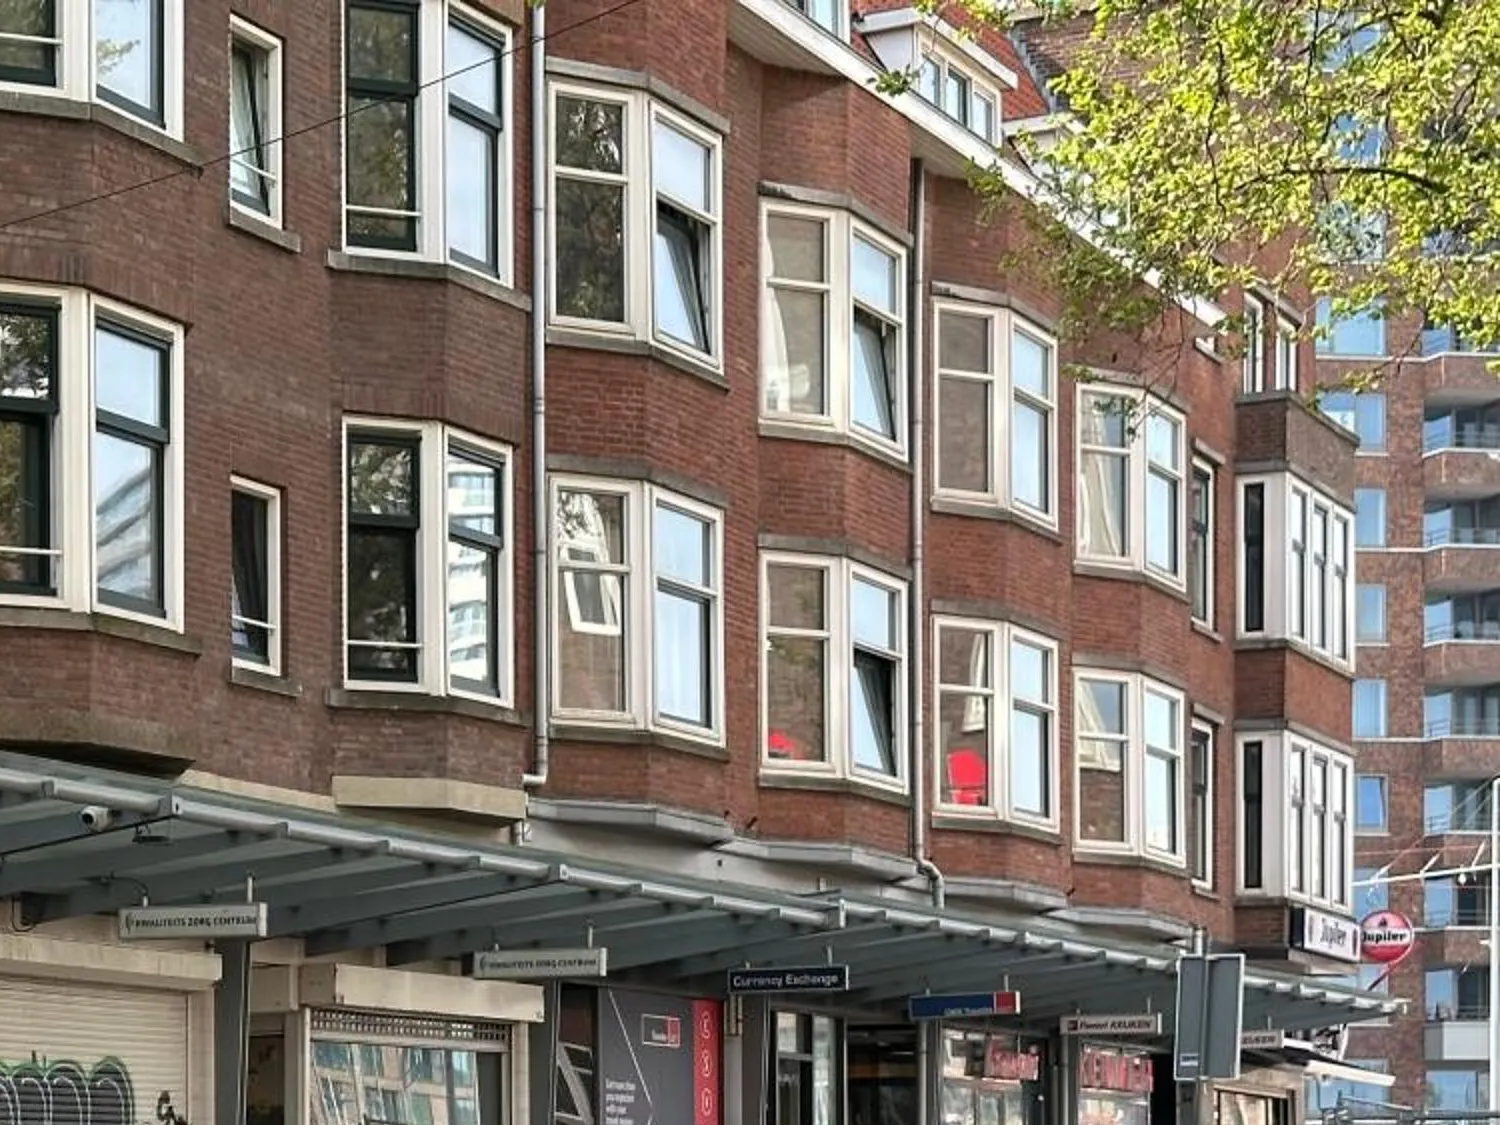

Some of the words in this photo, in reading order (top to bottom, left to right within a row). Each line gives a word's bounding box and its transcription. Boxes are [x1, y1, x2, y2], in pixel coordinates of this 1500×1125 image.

[1362, 930, 1407, 944] Jupiler
[733, 975, 783, 988] Currency
[785, 974, 839, 987] Exchange
